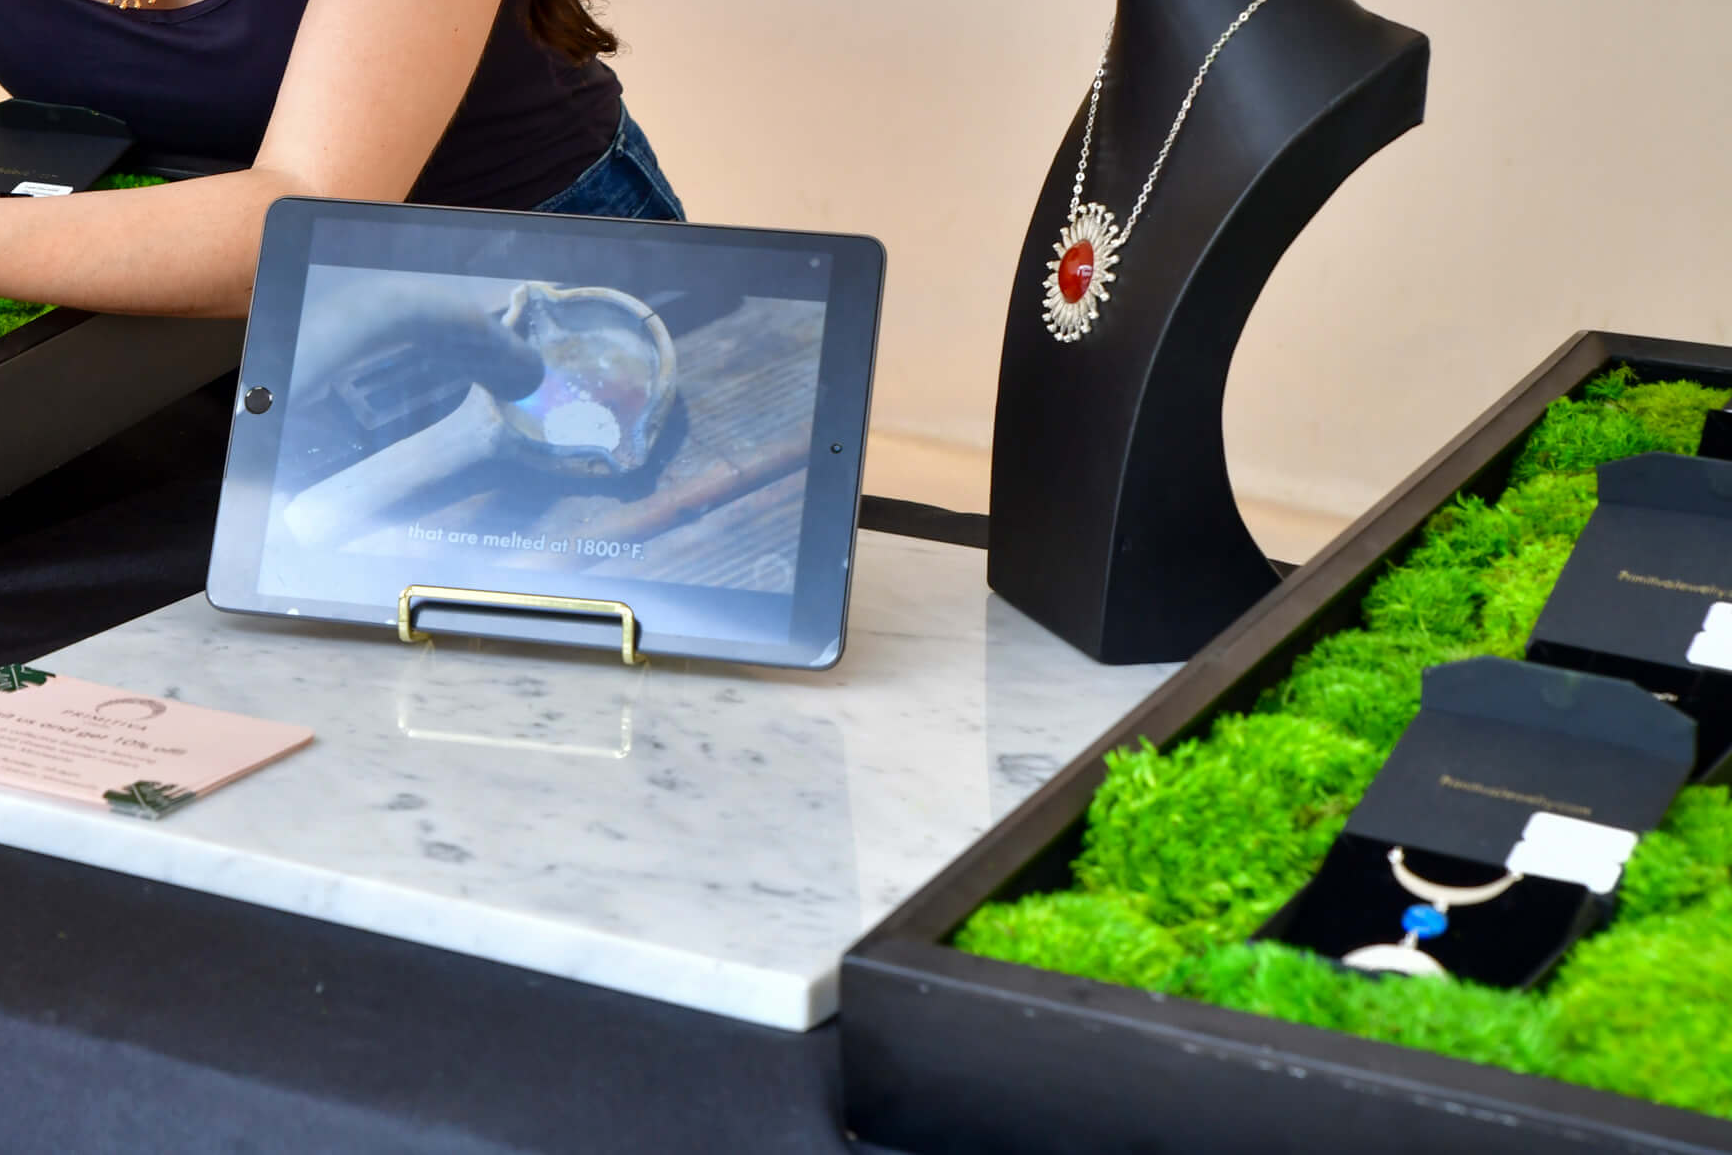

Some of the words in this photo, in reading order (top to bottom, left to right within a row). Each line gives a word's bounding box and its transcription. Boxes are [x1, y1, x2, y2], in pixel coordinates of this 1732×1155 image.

[408, 522, 443, 541] that
[447, 532, 477, 545] are
[483, 531, 545, 550] melted
[549, 539, 568, 552] at
[575, 539, 644, 560] 1800°F.
[39, 722, 78, 734] and
[60, 709, 147, 731] PRIMITIVA
